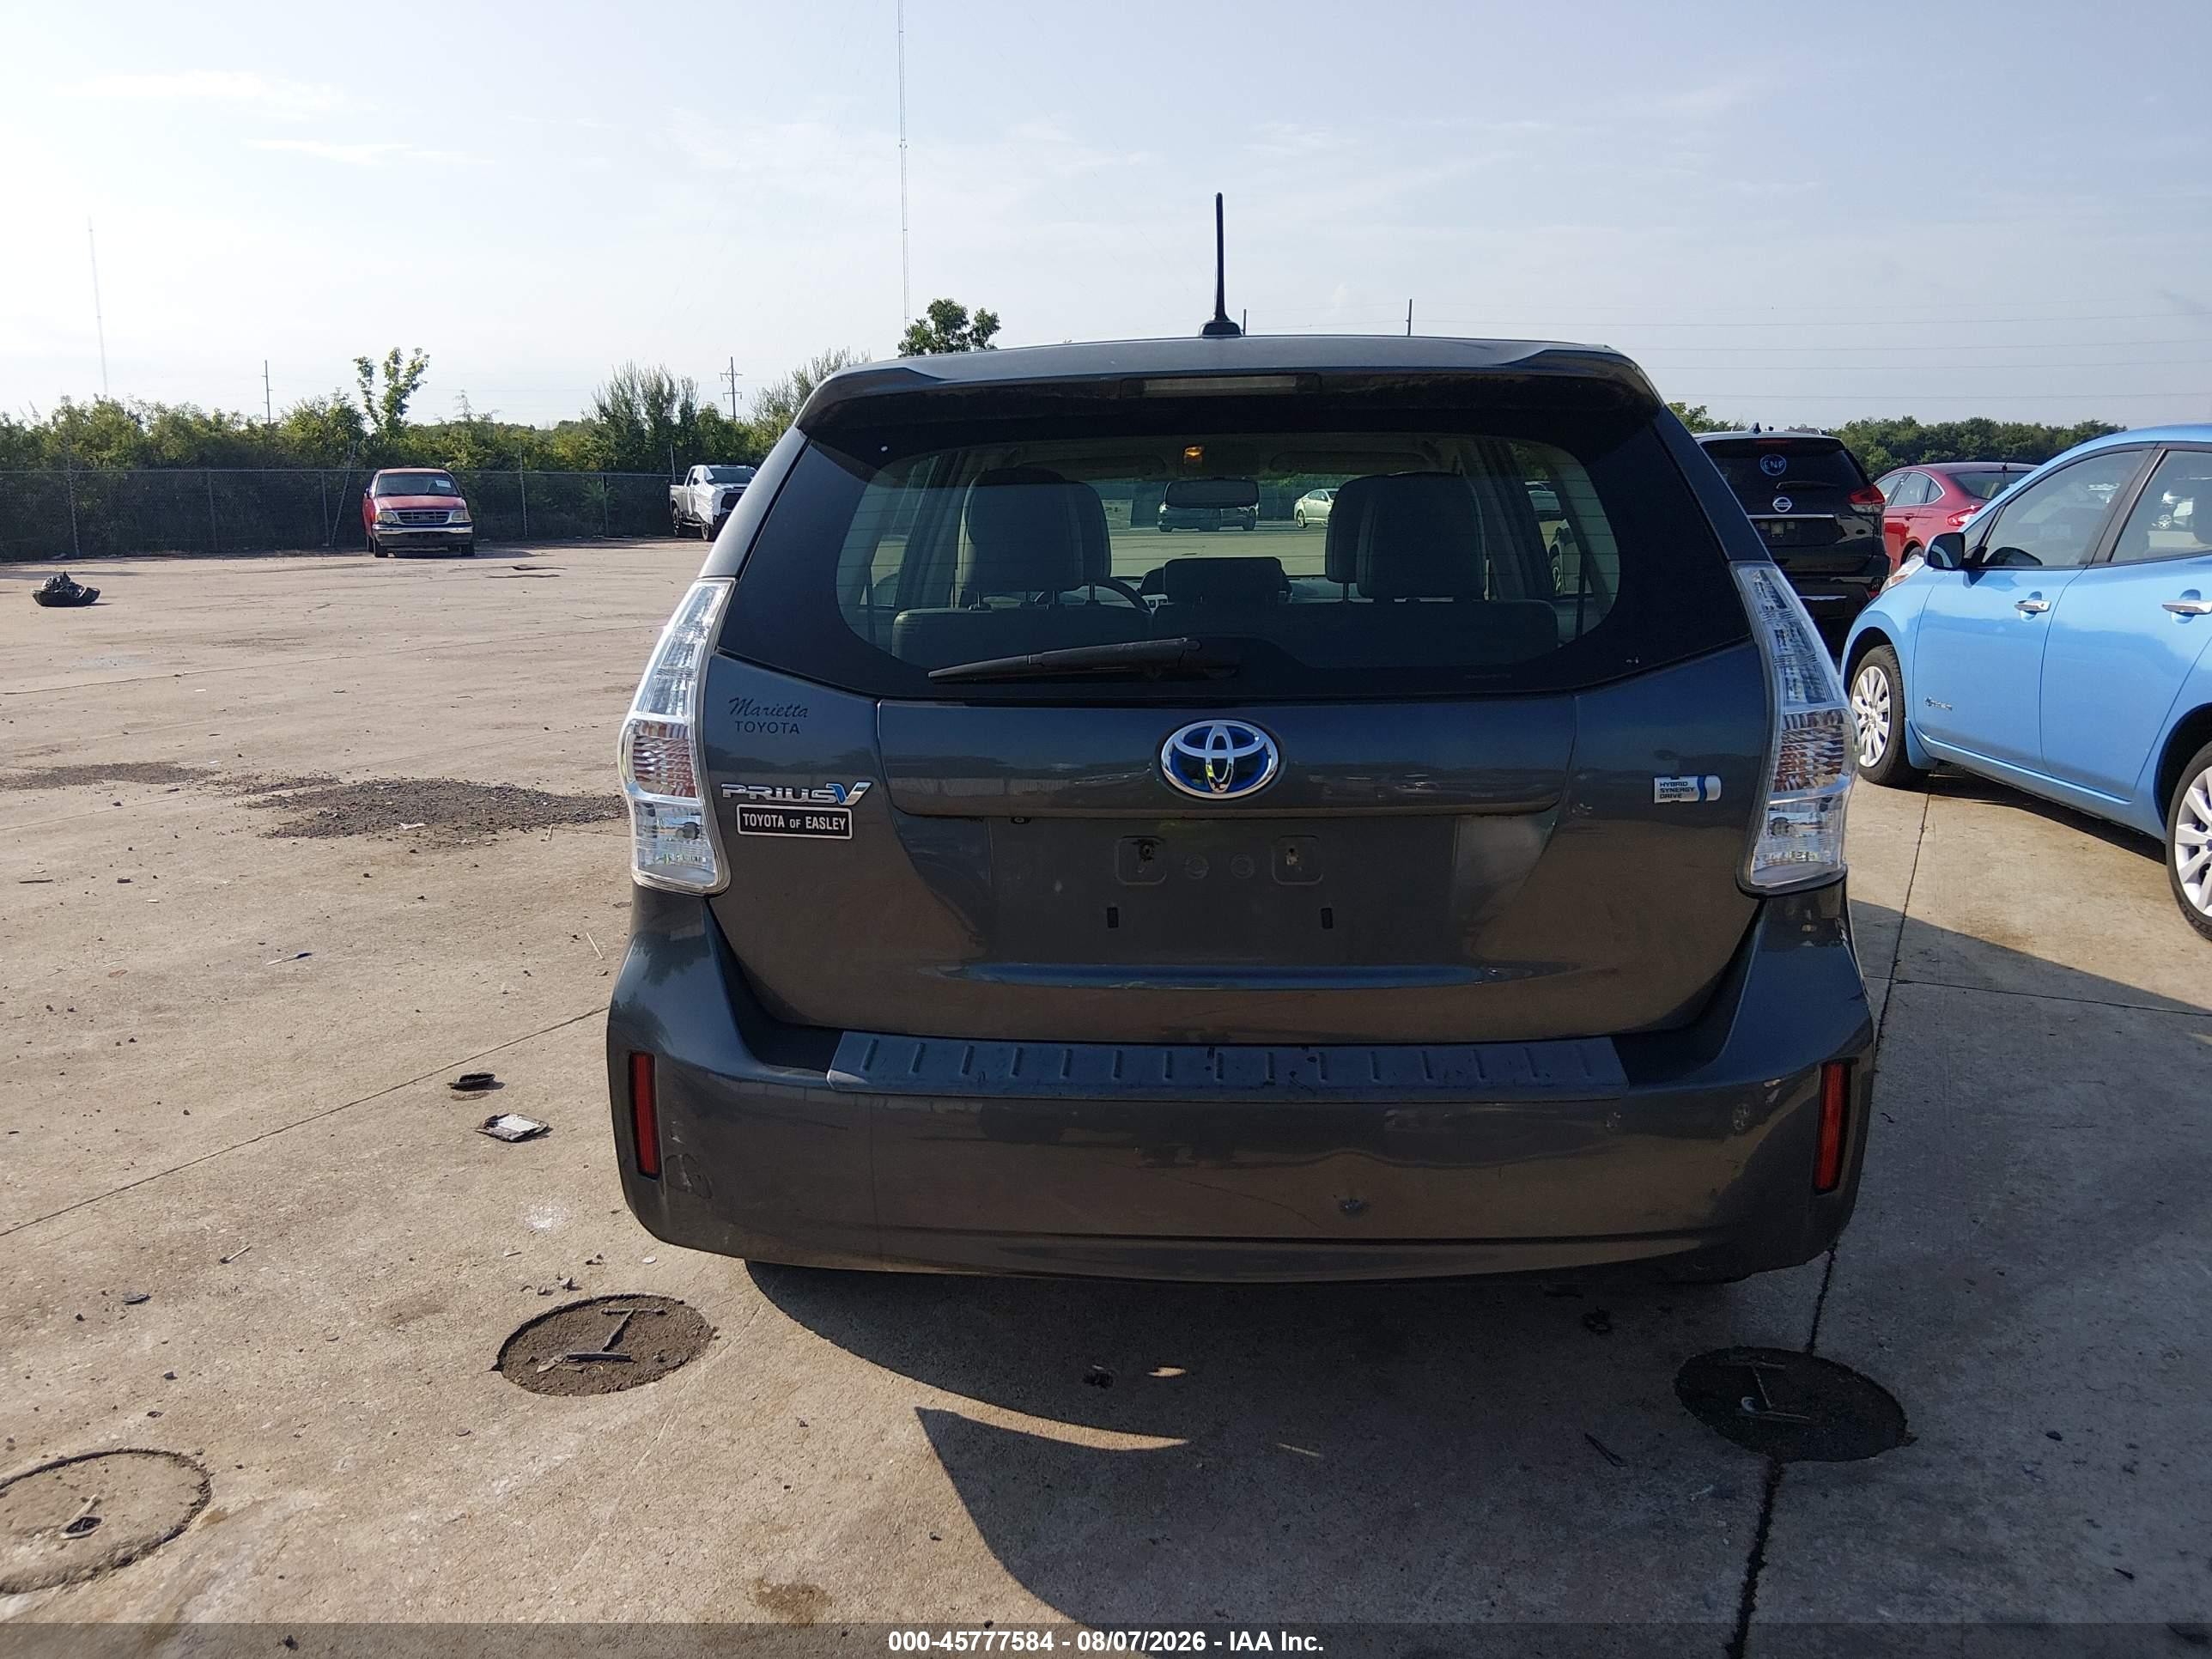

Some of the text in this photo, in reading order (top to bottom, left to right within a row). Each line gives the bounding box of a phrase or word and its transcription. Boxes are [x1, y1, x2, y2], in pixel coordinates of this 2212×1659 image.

[728, 697, 808, 718] Marietta
[735, 720, 800, 734] TOYOTA
[742, 813, 846, 830] TOYOTA OF EASLEY
